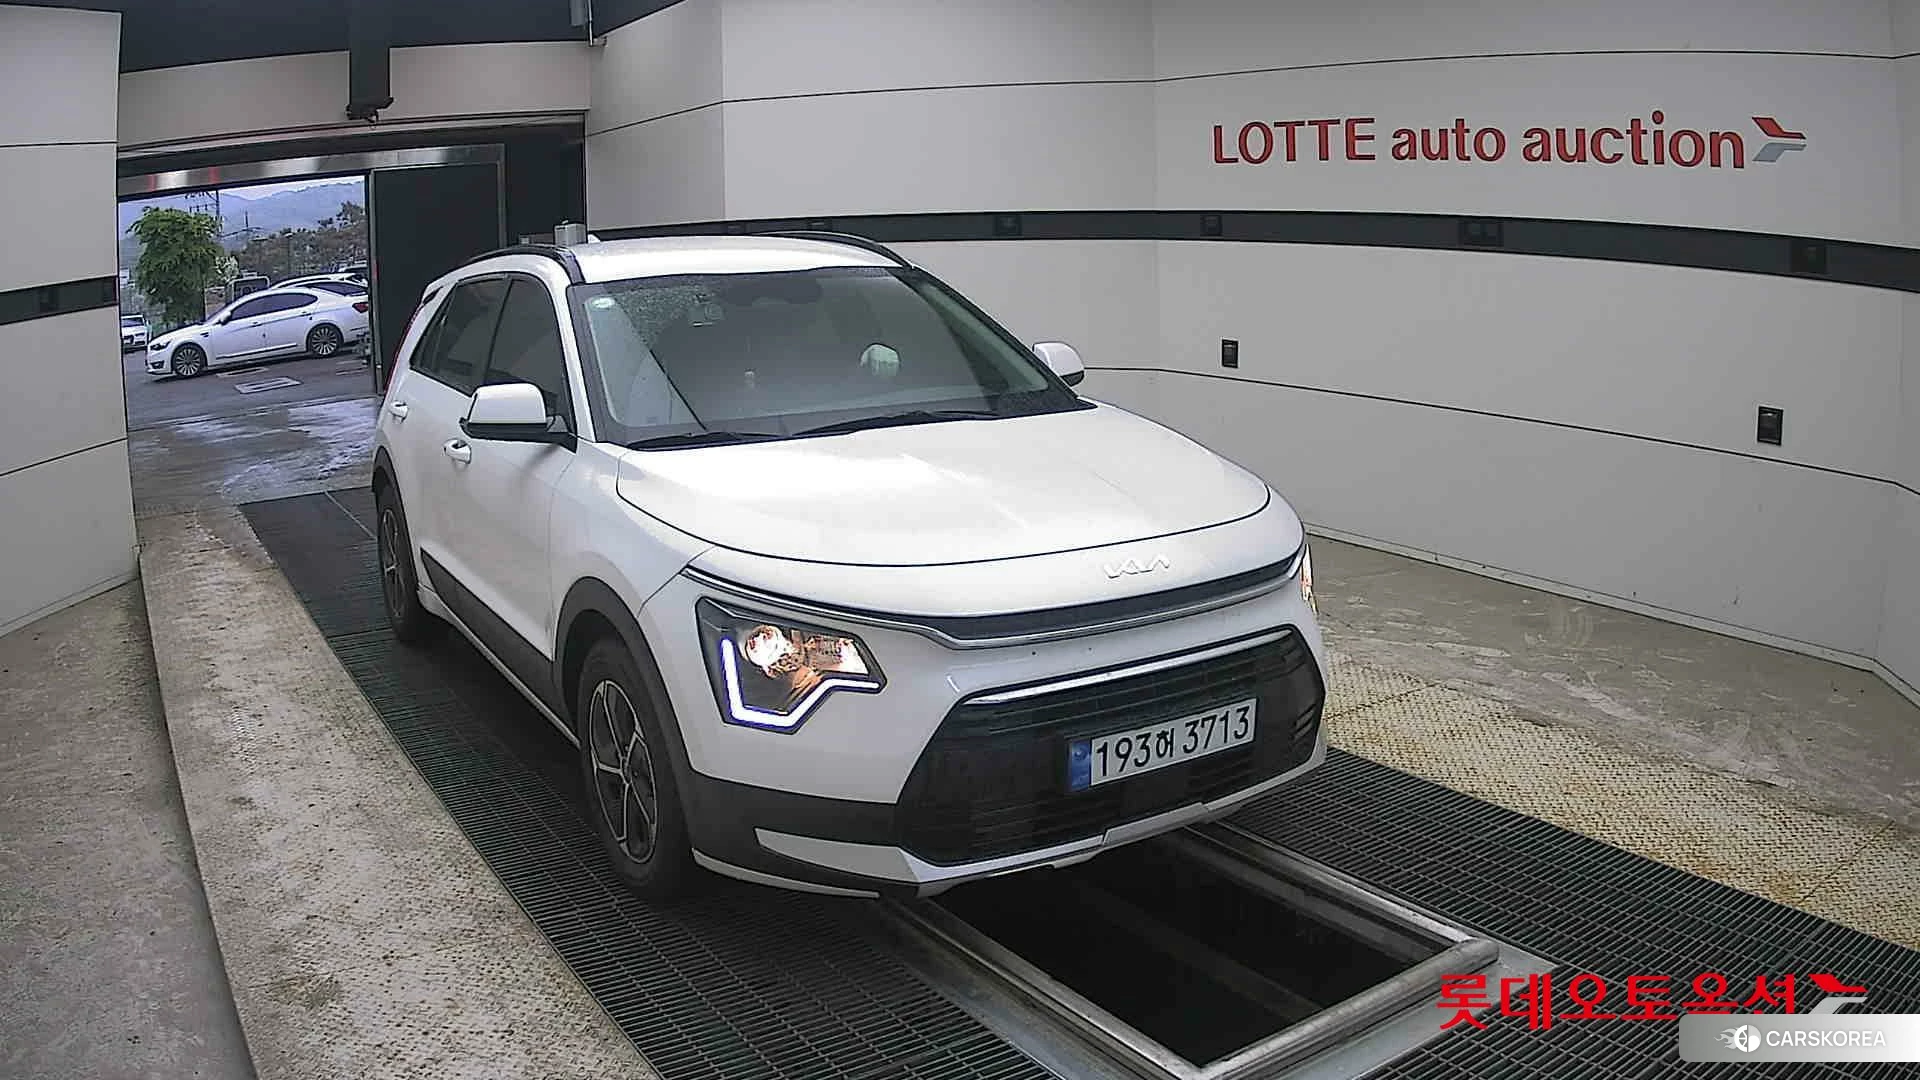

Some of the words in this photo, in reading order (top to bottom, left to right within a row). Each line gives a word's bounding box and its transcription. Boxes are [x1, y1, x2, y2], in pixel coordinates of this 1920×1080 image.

[1214, 117, 1376, 164] LOTTE
[1391, 118, 1506, 162] auto
[1523, 110, 1745, 168] auction
[1096, 727, 1175, 777] 193허
[1183, 706, 1251, 755] 3713
